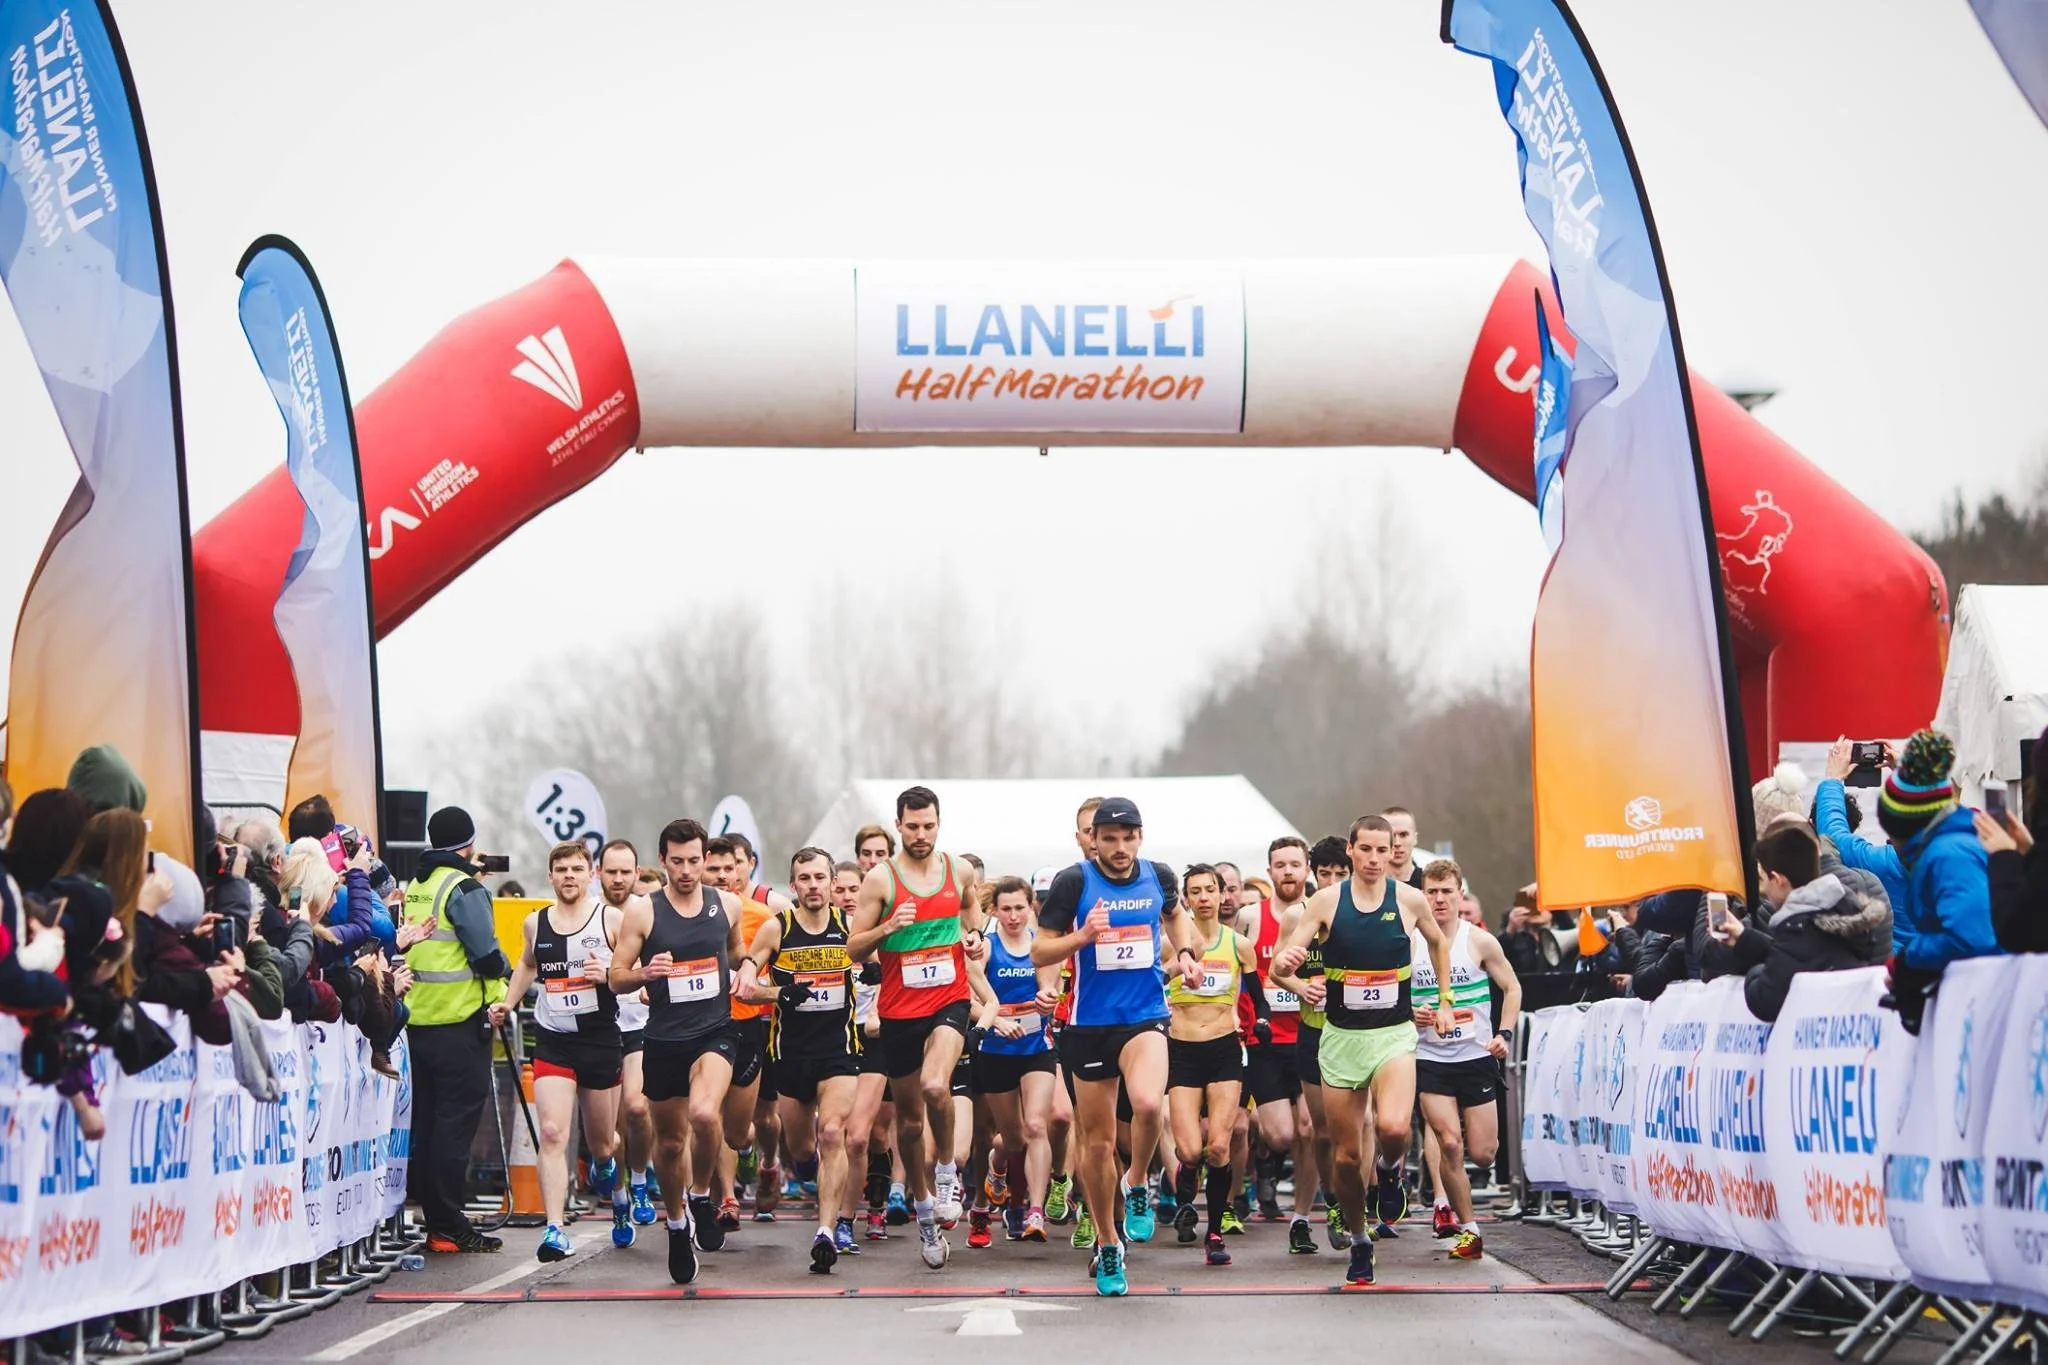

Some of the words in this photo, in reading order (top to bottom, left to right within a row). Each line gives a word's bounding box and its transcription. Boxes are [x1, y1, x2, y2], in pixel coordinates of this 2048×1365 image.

[896, 304, 1205, 358] LLANELLI
[546, 424, 580, 455] WELSH
[579, 389, 625, 432] ATHLETICS
[416, 458, 453, 492] UNITED
[423, 460, 468, 502] KINGDOM
[431, 465, 480, 512] ATHLETICS
[1101, 898, 1153, 911] CARDIFF
[789, 948, 823, 961] ABERDARE
[1116, 946, 1134, 960] 22
[922, 965, 937, 979] 17
[687, 977, 705, 991] 18
[562, 993, 580, 1007] 10
[1276, 991, 1300, 1003] 580
[1363, 988, 1381, 1001] 23
